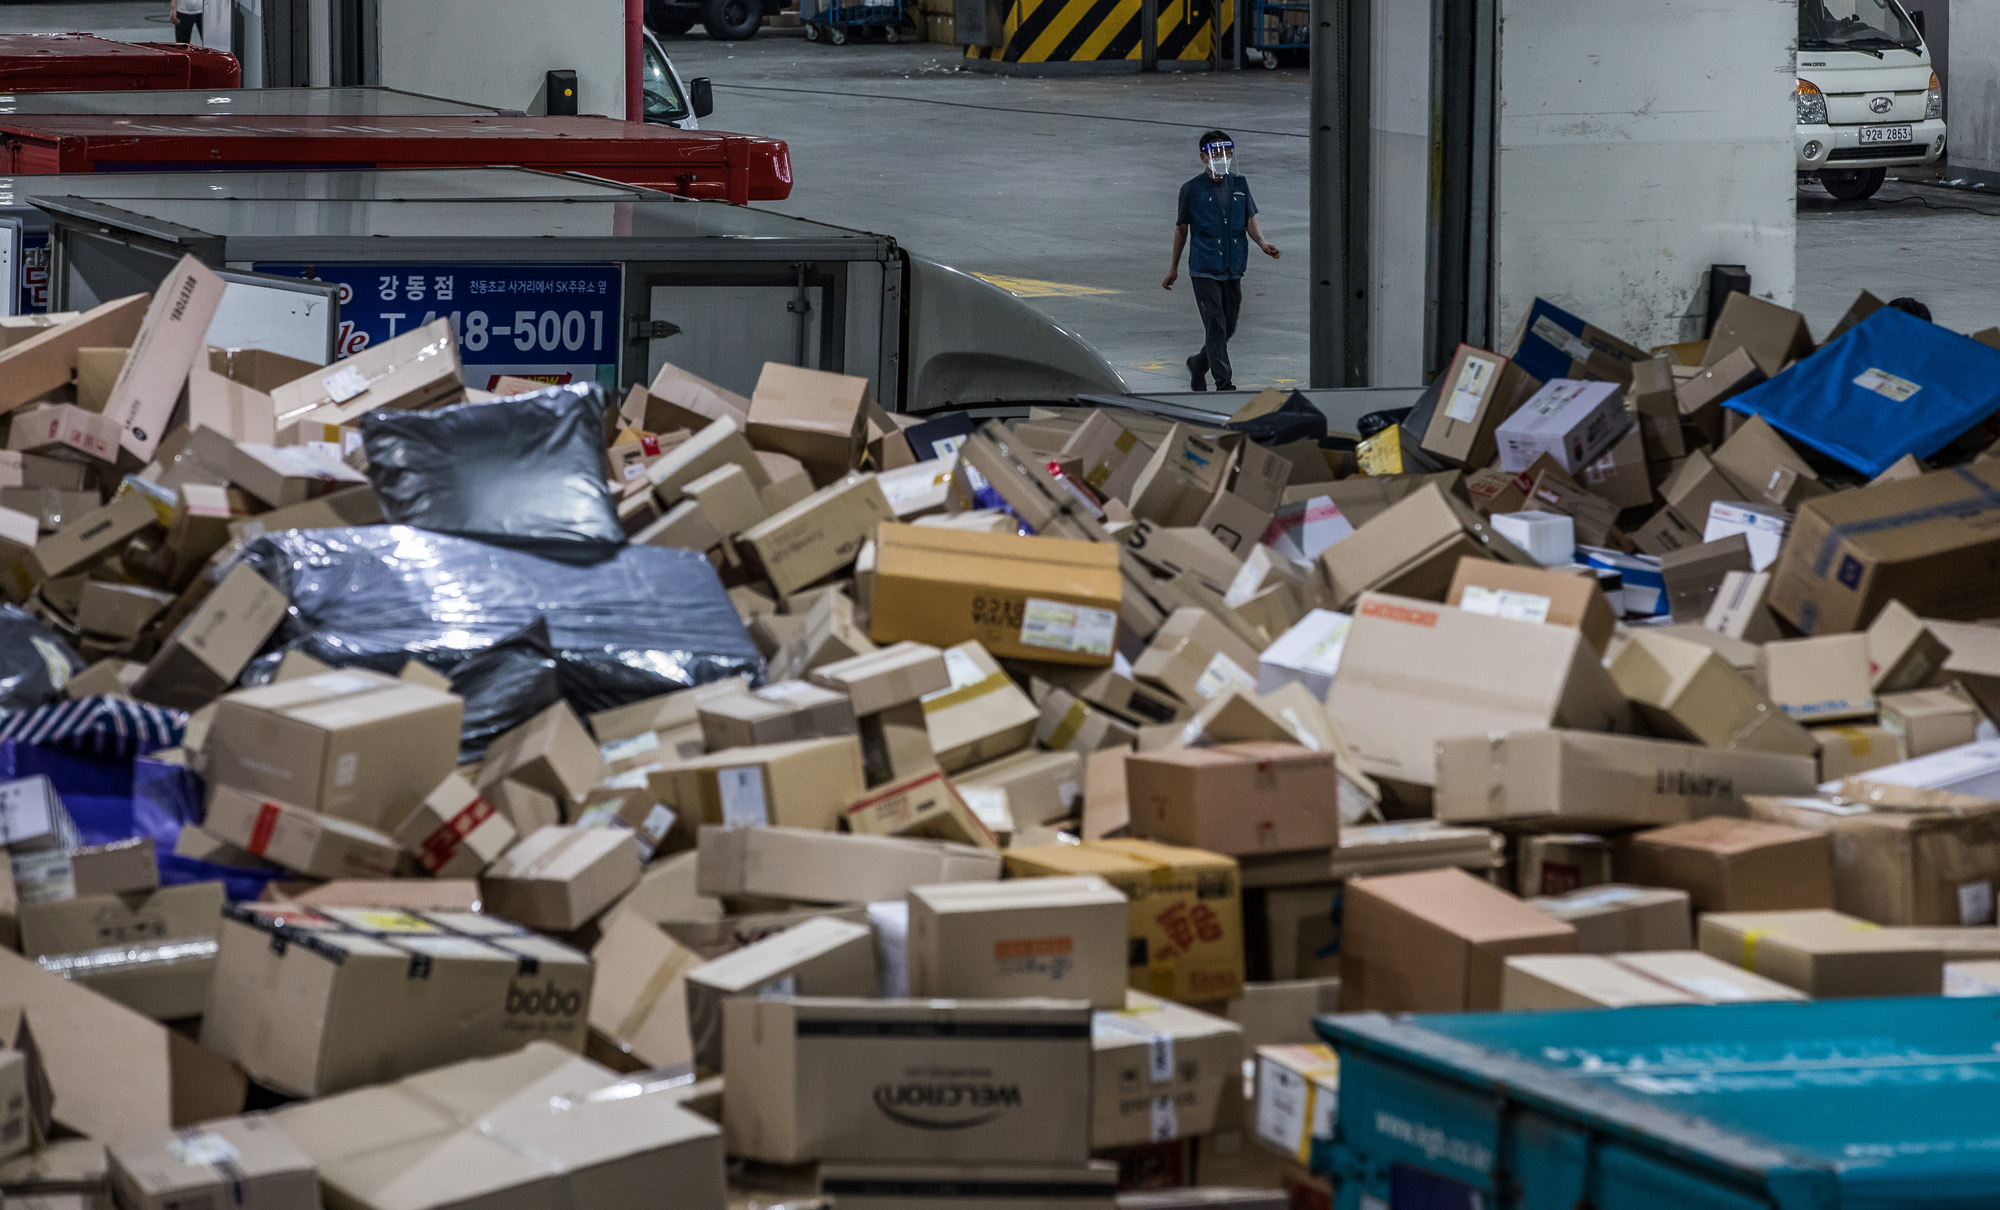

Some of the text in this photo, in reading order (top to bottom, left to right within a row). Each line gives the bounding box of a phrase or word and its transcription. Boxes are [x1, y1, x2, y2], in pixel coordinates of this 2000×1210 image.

[1886, 128, 1908, 140] 2853
[378, 275, 454, 301] 강동점
[469, 280, 607, 294] 천동초교 사거리에서 SK주유소 옆
[505, 979, 583, 1017] bobo
